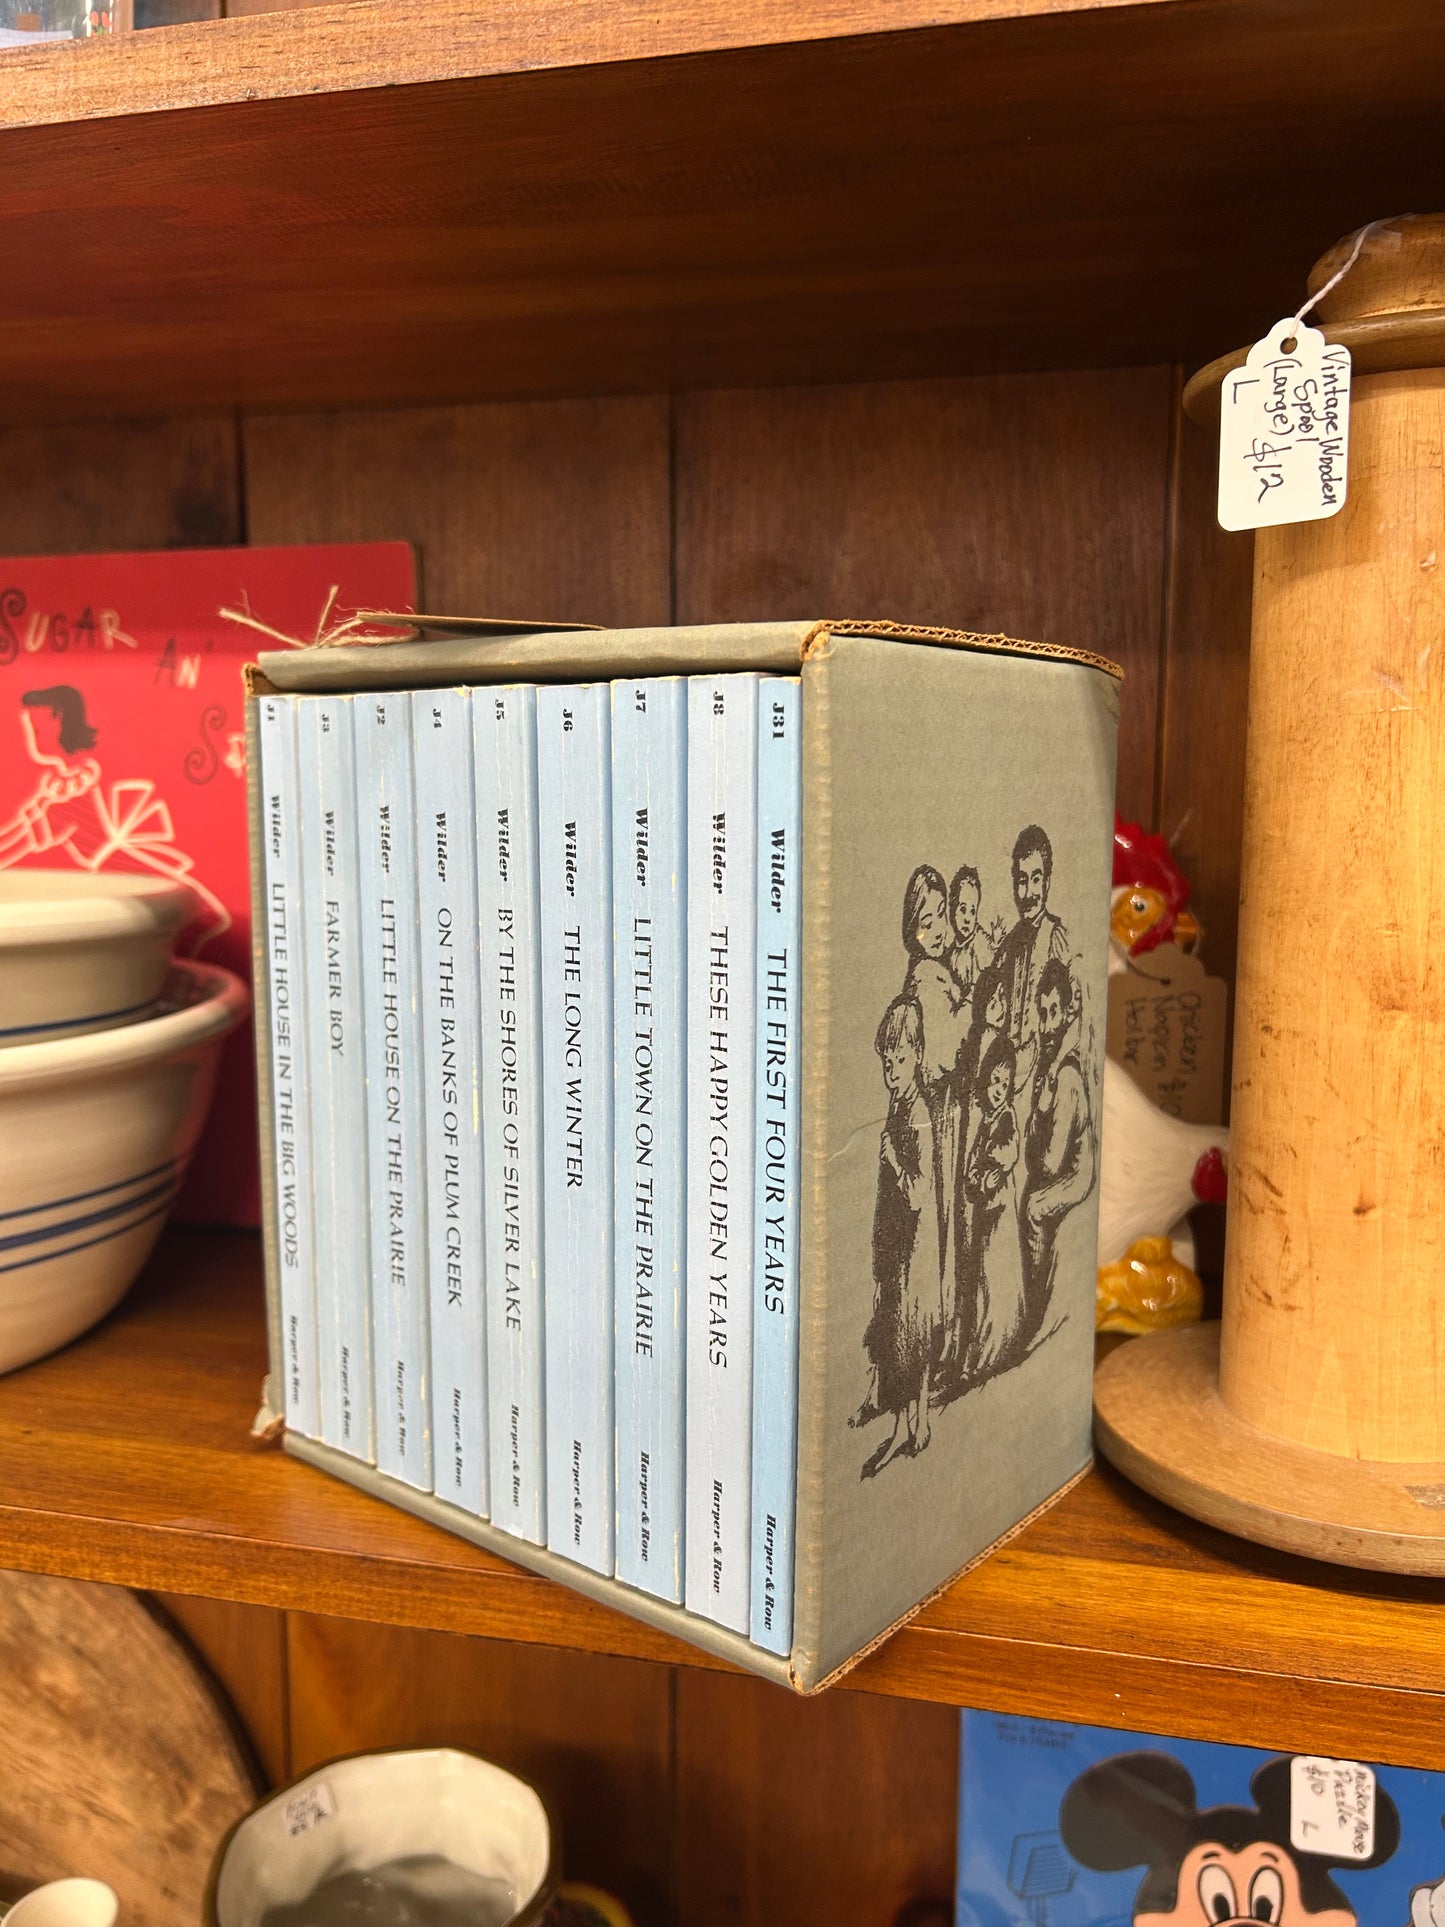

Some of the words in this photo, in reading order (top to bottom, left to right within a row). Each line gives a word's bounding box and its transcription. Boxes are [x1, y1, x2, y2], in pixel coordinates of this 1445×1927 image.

[1233, 379, 1260, 404] L
[1263, 358, 1303, 435] (Large)
[1291, 378, 1320, 442] Spool
[1312, 351, 1350, 435] Vintage
[1243, 438, 1292, 503] $12
[1318, 437, 1344, 506] Wooden
[376, 705, 386, 725] J2
[432, 708, 442, 729] J4
[495, 698, 505, 720] J5
[562, 708, 573, 732] J6
[635, 690, 646, 713] J7
[713, 691, 724, 715] J8
[772, 702, 785, 739] J31
[270, 795, 281, 858] Wilder
[324, 810, 335, 876] Wilder
[379, 805, 391, 873] Wilder
[435, 812, 448, 882] Wilder
[497, 808, 510, 882] Wilder
[635, 808, 649, 887] Wilder
[712, 812, 727, 894] Wilder
[564, 821, 578, 897] Wilder
[770, 828, 785, 913] Wilder
[272, 883, 288, 961] LITTLE
[326, 900, 343, 1000] FARMER
[381, 899, 398, 984] LITTLE
[437, 907, 453, 947] ON
[498, 908, 514, 939] BY
[564, 925, 581, 982] THE
[439, 957, 455, 1010] THE
[499, 947, 516, 1001] THE
[633, 917, 653, 1017] LITTLE
[709, 925, 729, 1021] THESE
[767, 948, 788, 1012] THE
[275, 967, 291, 1047] HOUSE
[329, 1009, 344, 1057] BOY
[384, 994, 400, 1078] HOUSE
[564, 992, 582, 1068] LONG
[277, 1054, 292, 1080] IN
[440, 1018, 458, 1105] BANKS
[500, 1009, 519, 1116] SHORES
[634, 1027, 653, 1116] TOWN
[709, 1030, 729, 1131] HAPPY
[766, 1021, 788, 1110] FIRST
[280, 1088, 294, 1136] THE
[386, 1086, 401, 1124] ON
[443, 1111, 459, 1147] OF
[566, 1078, 583, 1188] WINTER
[281, 1140, 296, 1176] BIG
[388, 1133, 404, 1184] THE
[503, 1123, 520, 1159] OF
[635, 1123, 653, 1168] ON
[765, 1119, 786, 1204] FOUR
[444, 1154, 460, 1219] PLUM
[503, 1166, 520, 1253] SILVER
[635, 1178, 653, 1236] THE
[709, 1135, 729, 1261] GOLDEN
[282, 1183, 299, 1269] WOODS
[389, 1190, 406, 1287] PRAIRIE
[446, 1226, 462, 1308] CREEK
[764, 1214, 785, 1315] YEARS
[505, 1262, 522, 1331] LAKE
[635, 1245, 653, 1358] PRAIRIE
[709, 1272, 728, 1368] YEARS
[455, 1441, 462, 1452] &
[511, 1404, 519, 1458] Harper
[455, 1455, 463, 1487] Row
[512, 1459, 520, 1471] &
[512, 1475, 521, 1507] Row
[572, 1439, 582, 1495] Harper
[639, 1450, 650, 1509] Harper
[573, 1513, 583, 1546] Row
[574, 1496, 582, 1510] &
[641, 1510, 650, 1524] &
[711, 1479, 723, 1540] Harper
[640, 1527, 650, 1562] Row
[712, 1557, 723, 1594] Row
[713, 1541, 723, 1554] &
[763, 1513, 777, 1576] Harper
[764, 1594, 775, 1631] Row
[765, 1576, 776, 1591] &
